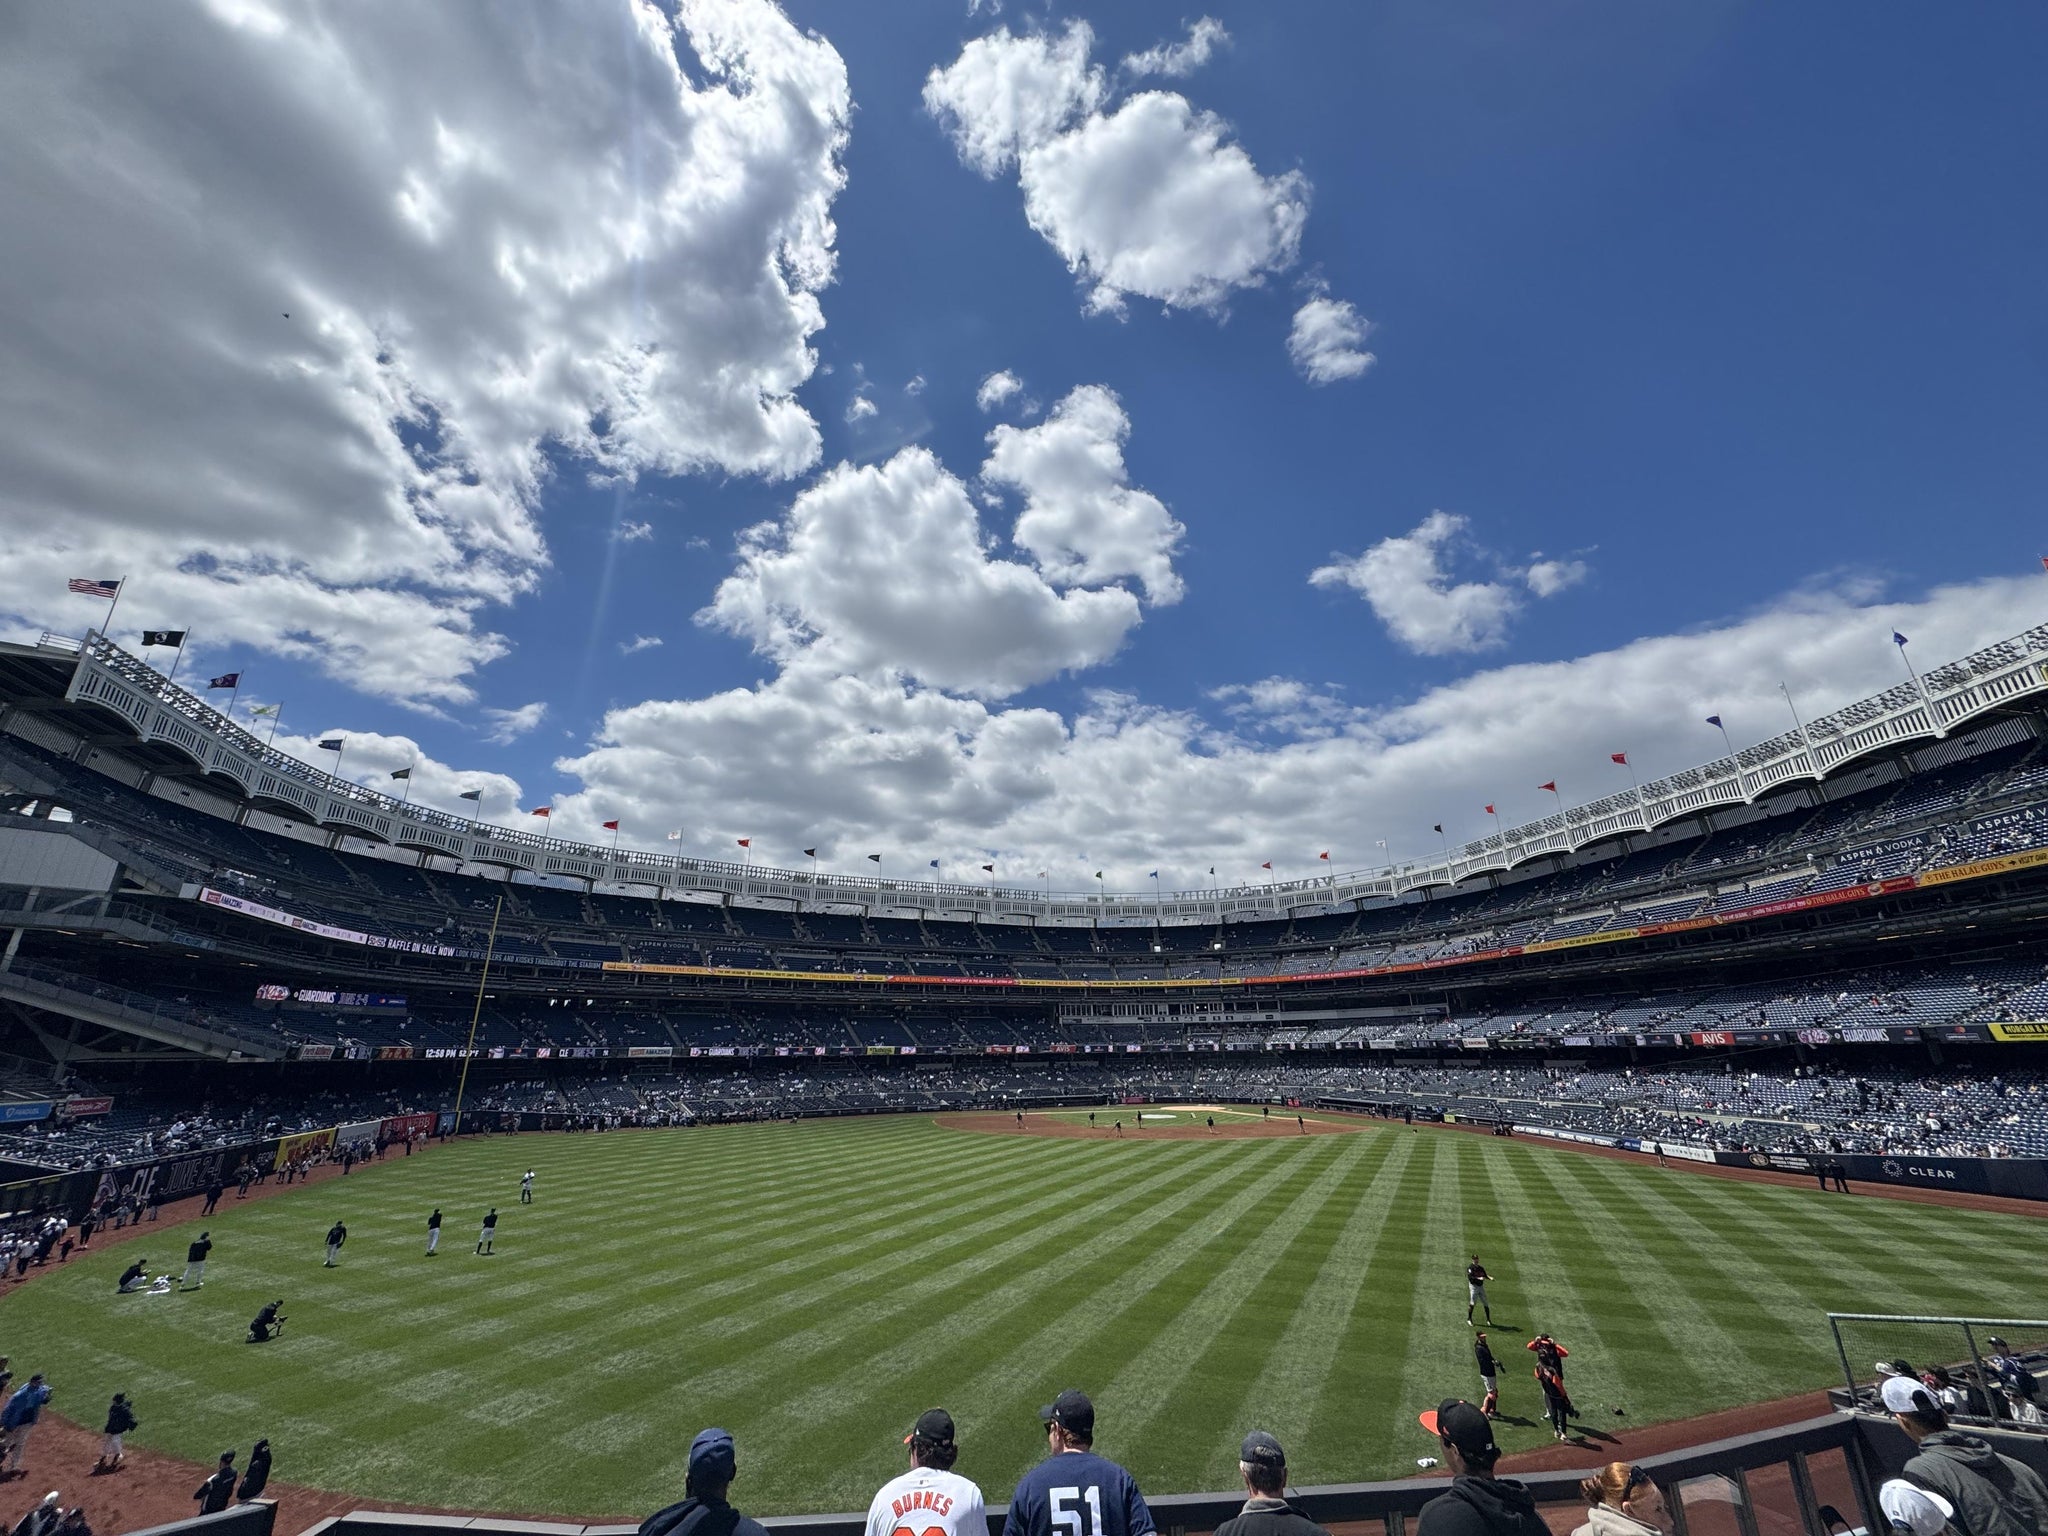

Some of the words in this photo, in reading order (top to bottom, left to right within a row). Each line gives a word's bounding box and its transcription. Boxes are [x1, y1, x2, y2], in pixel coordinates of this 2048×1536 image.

[1976, 814, 2020, 831] ASPEN
[1840, 849, 1873, 862] ASPEN
[1884, 838, 1923, 852] VODKA
[1934, 870, 1951, 881] THE
[1952, 866, 1979, 879] HALAL
[1980, 860, 2006, 872] GUYS
[2018, 856, 2034, 865] VISIT
[1812, 897, 1826, 905] THE
[1826, 892, 1846, 903] HALAL
[1848, 888, 1866, 897] GUYS
[1668, 923, 1680, 931] THE
[1680, 921, 1698, 929] HALAL
[1699, 919, 1712, 927] GUYS
[387, 938, 411, 952] RAFFLE
[412, 942, 420, 953] ON
[420, 944, 438, 955] SALE
[438, 946, 456, 957] NOW
[456, 949, 469, 959] LOOK
[470, 951, 480, 959] FOR
[480, 952, 502, 962] SELERS
[503, 955, 515, 963] AND
[515, 956, 534, 964] KIOSKS
[535, 958, 568, 967] THROUGHOUT
[568, 960, 578, 968] THE
[578, 961, 602, 969] STADIUM
[298, 990, 337, 1004] GUARDIANS
[1842, 1028, 1890, 1042] GUARDIANS
[2004, 1025, 2036, 1034] MORGAN
[2036, 1025, 2042, 1033] &
[1564, 1037, 1591, 1046] GUARDIANS
[1702, 1033, 1726, 1044] AVIS
[426, 1049, 445, 1058] 12:58
[445, 1049, 457, 1058] PM
[559, 1049, 569, 1058] CLE
[709, 1048, 735, 1056] GUARDIANS
[160, 1159, 203, 1196] JUNE
[197, 1153, 225, 1188] 2-4
[1909, 1166, 1956, 1179] CLEAR
[892, 1490, 954, 1519] BURNES
[1049, 1486, 1102, 1536] 51
